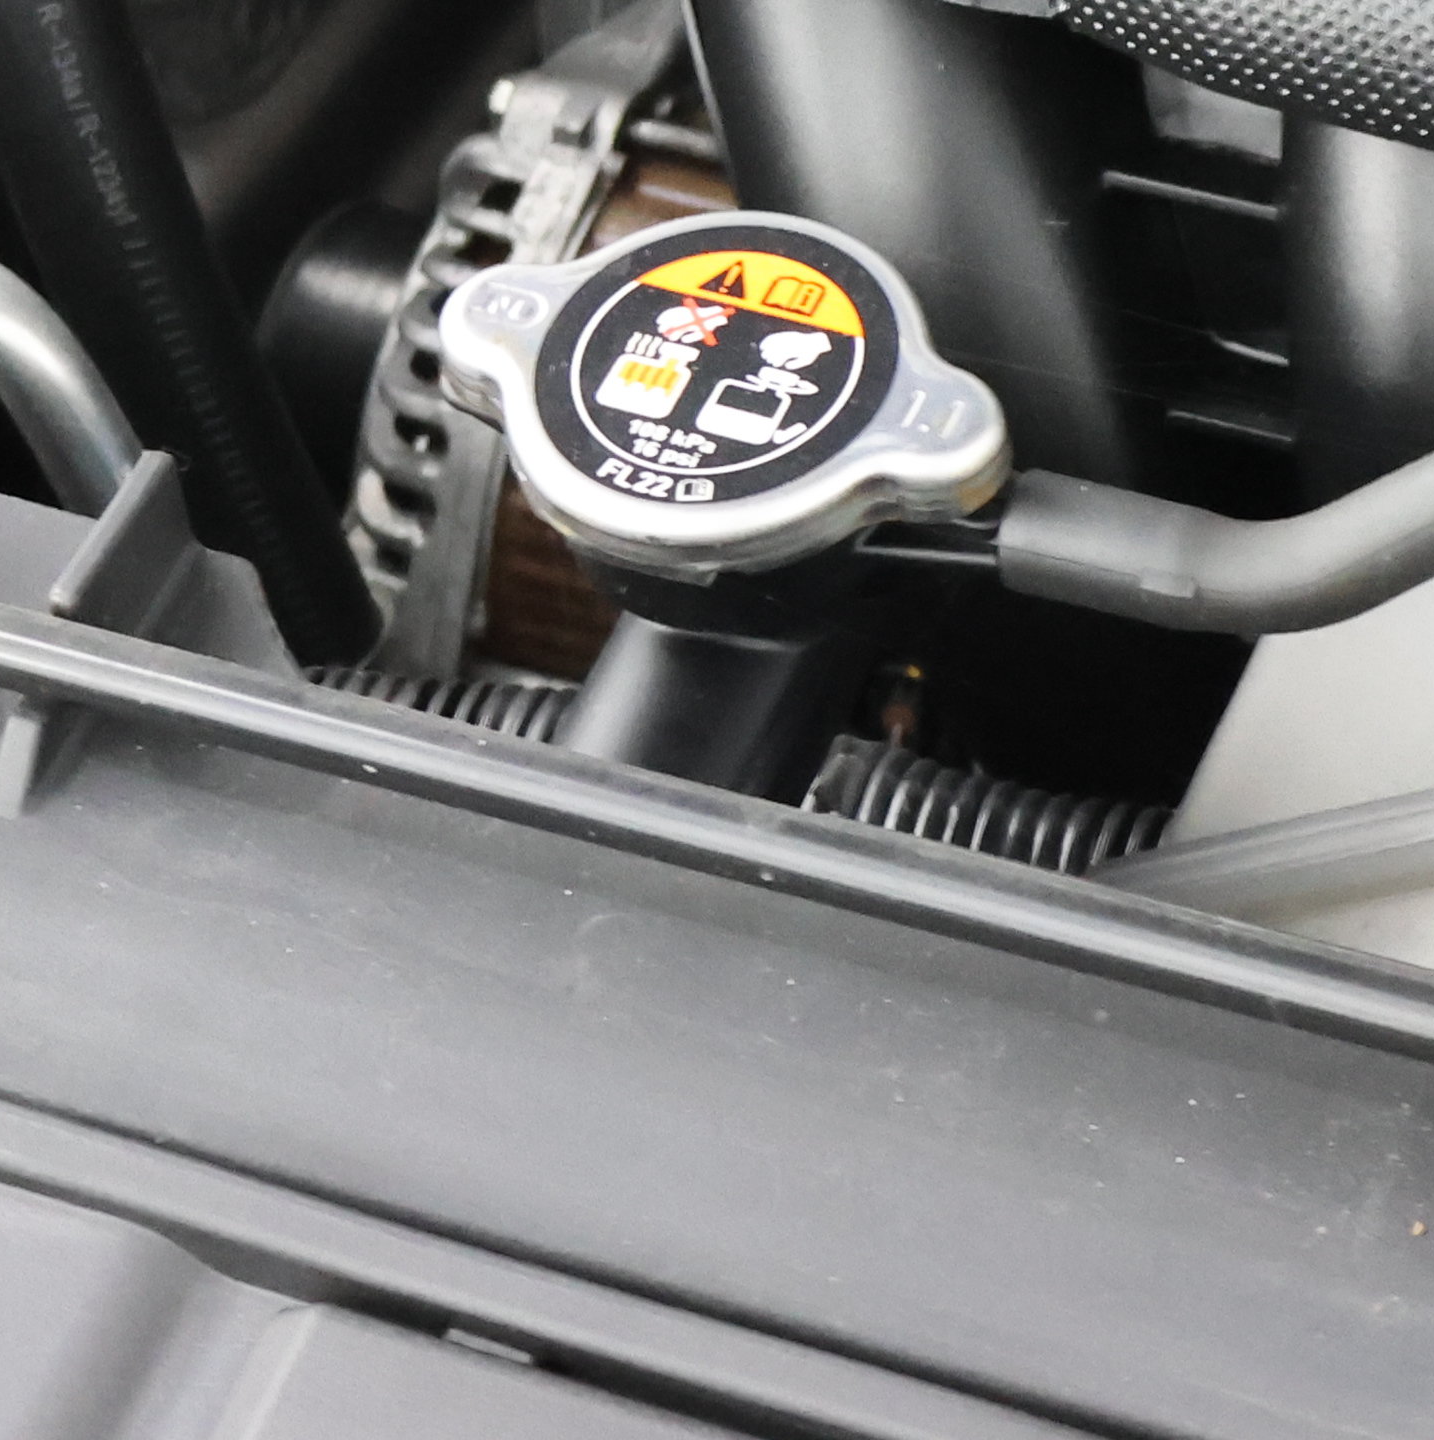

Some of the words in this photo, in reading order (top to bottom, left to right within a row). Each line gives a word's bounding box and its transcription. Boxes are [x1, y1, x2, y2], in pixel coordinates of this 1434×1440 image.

[633, 438, 662, 458] 16
[658, 448, 702, 468] psi
[669, 428, 717, 454] kPa
[596, 457, 674, 498] FL22
